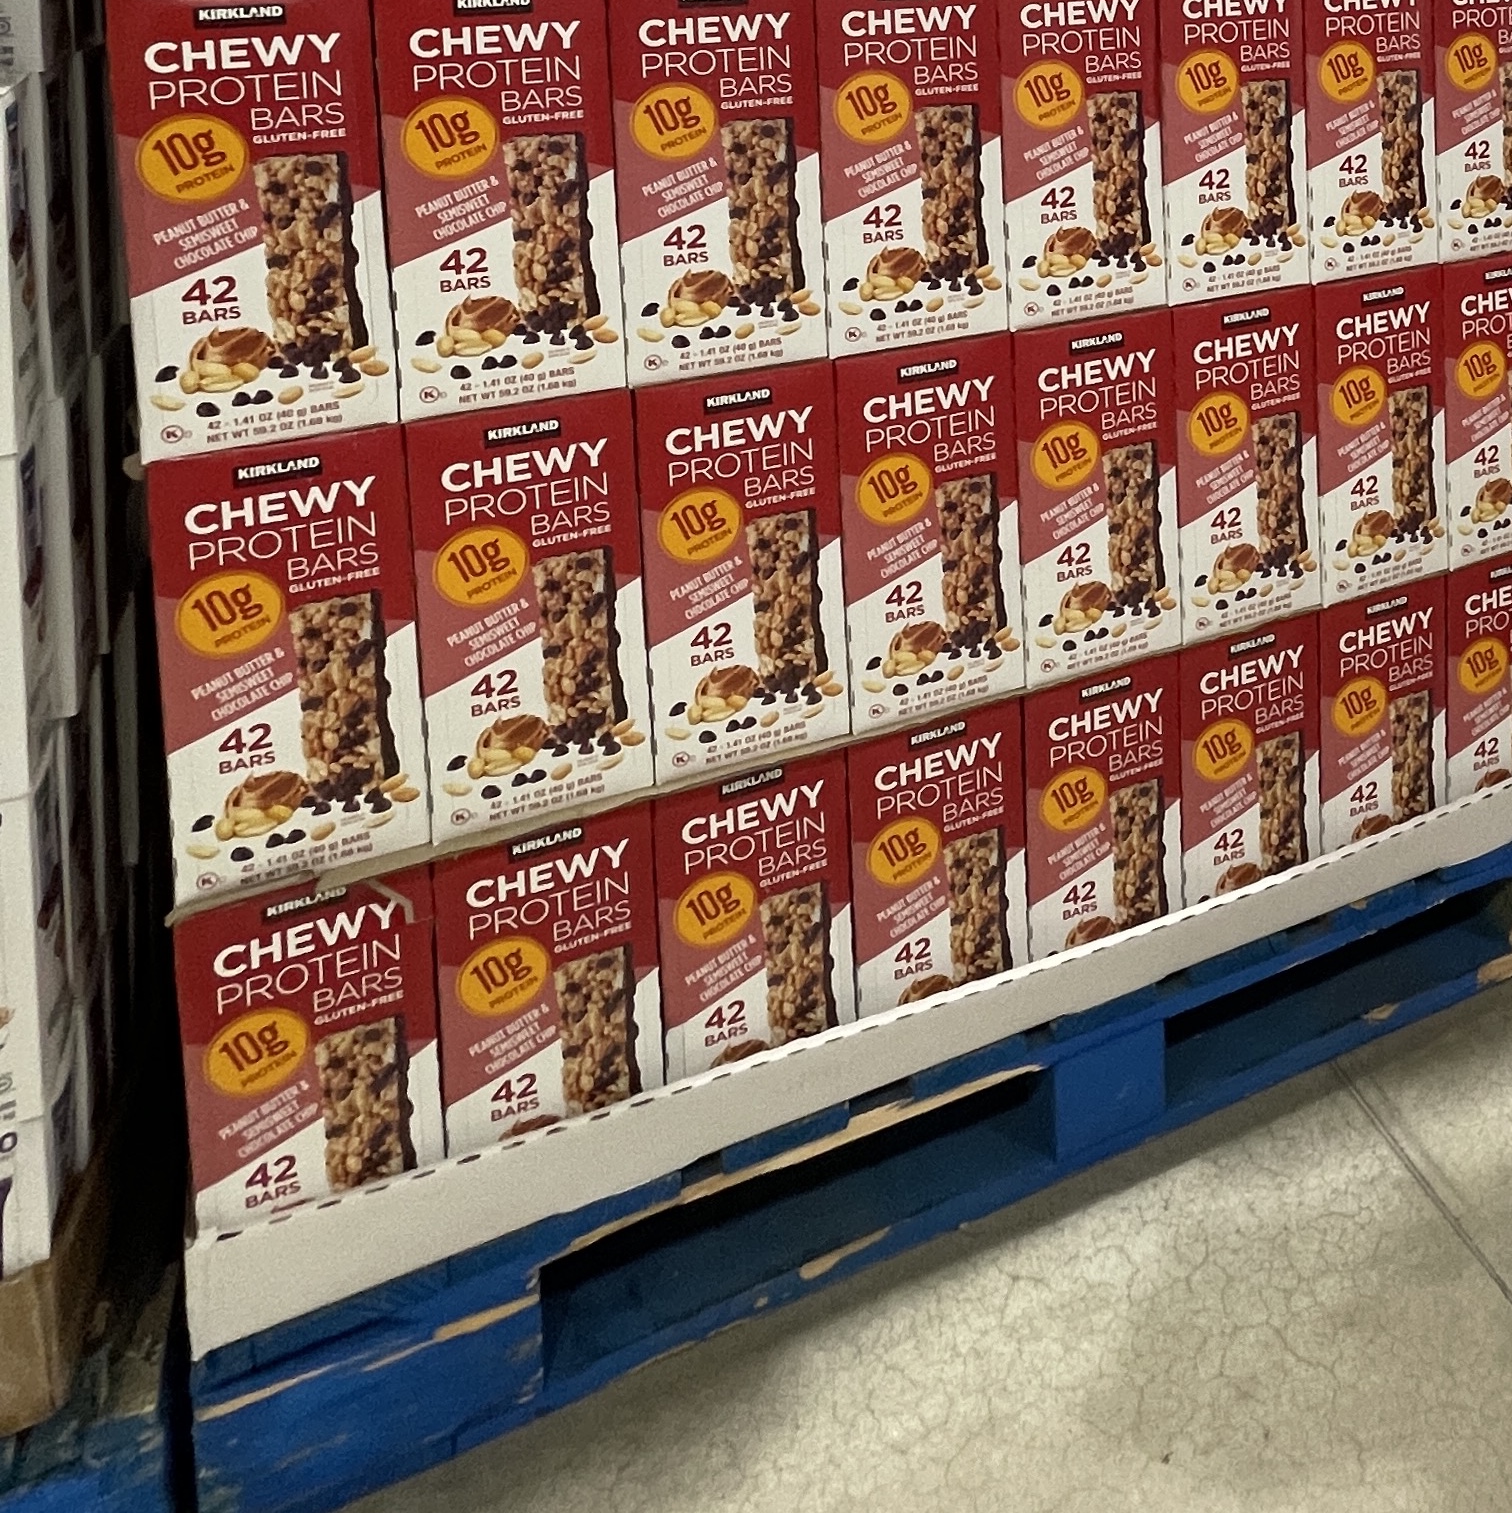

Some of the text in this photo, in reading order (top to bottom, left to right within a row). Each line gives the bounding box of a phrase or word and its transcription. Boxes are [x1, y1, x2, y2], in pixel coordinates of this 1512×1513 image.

[199, 6, 282, 19] KIRKLAND
[144, 33, 340, 73] CHEWY
[1024, 26, 1140, 56] PROTEIN
[1086, 52, 1142, 72] BARS
[149, 70, 341, 110] PROTEIN
[1026, 72, 1070, 107] 10g
[252, 103, 344, 130] BARS
[253, 128, 346, 143] GLUTEN-FREE
[153, 130, 226, 175] 10g
[175, 165, 235, 193] PROTEIN
[1041, 186, 1074, 209] 42
[1041, 210, 1076, 224] BARS
[182, 276, 238, 305] 42
[183, 306, 241, 325] BARS
[707, 389, 770, 406] KIRKLAND
[666, 407, 813, 455] CHEWY
[669, 439, 812, 487] PROTEIN
[745, 467, 814, 496] BARS
[746, 488, 815, 507] GLUTEN-FREE
[671, 499, 725, 541] 10g
[691, 622, 732, 649] 42
[691, 647, 734, 667] BARS
[266, 885, 347, 916] KIRKLAND
[213, 897, 402, 978] CHEWY
[218, 934, 401, 1014] PROTEIN
[314, 966, 403, 1011] BARS
[221, 1021, 289, 1071] 10g
[246, 1155, 297, 1188] 42
[246, 1181, 300, 1208] BARS
